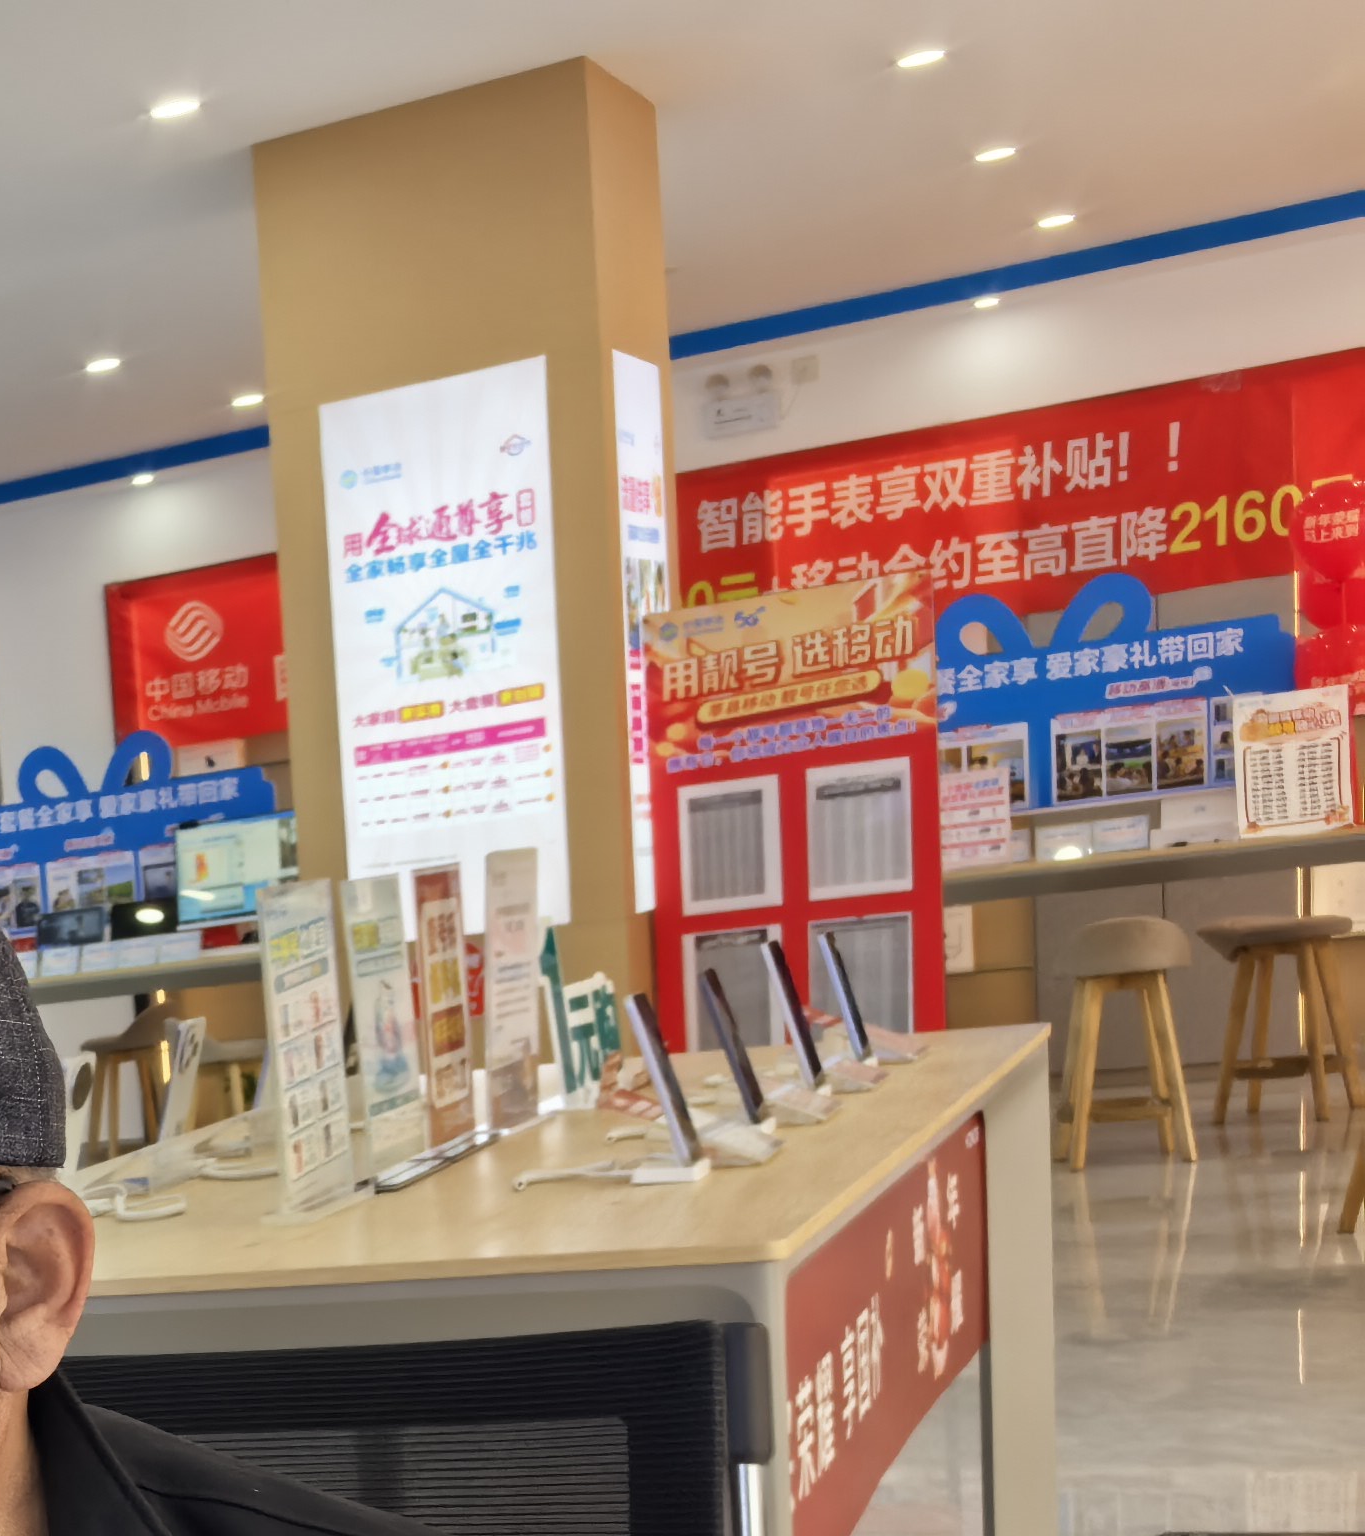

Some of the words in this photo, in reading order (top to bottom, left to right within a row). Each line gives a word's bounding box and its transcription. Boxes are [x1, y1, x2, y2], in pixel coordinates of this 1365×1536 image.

[663, 640, 780, 701] 用靓号
[792, 616, 913, 678] 选移动
[1046, 628, 1244, 680] 爱家豪礼带回家
